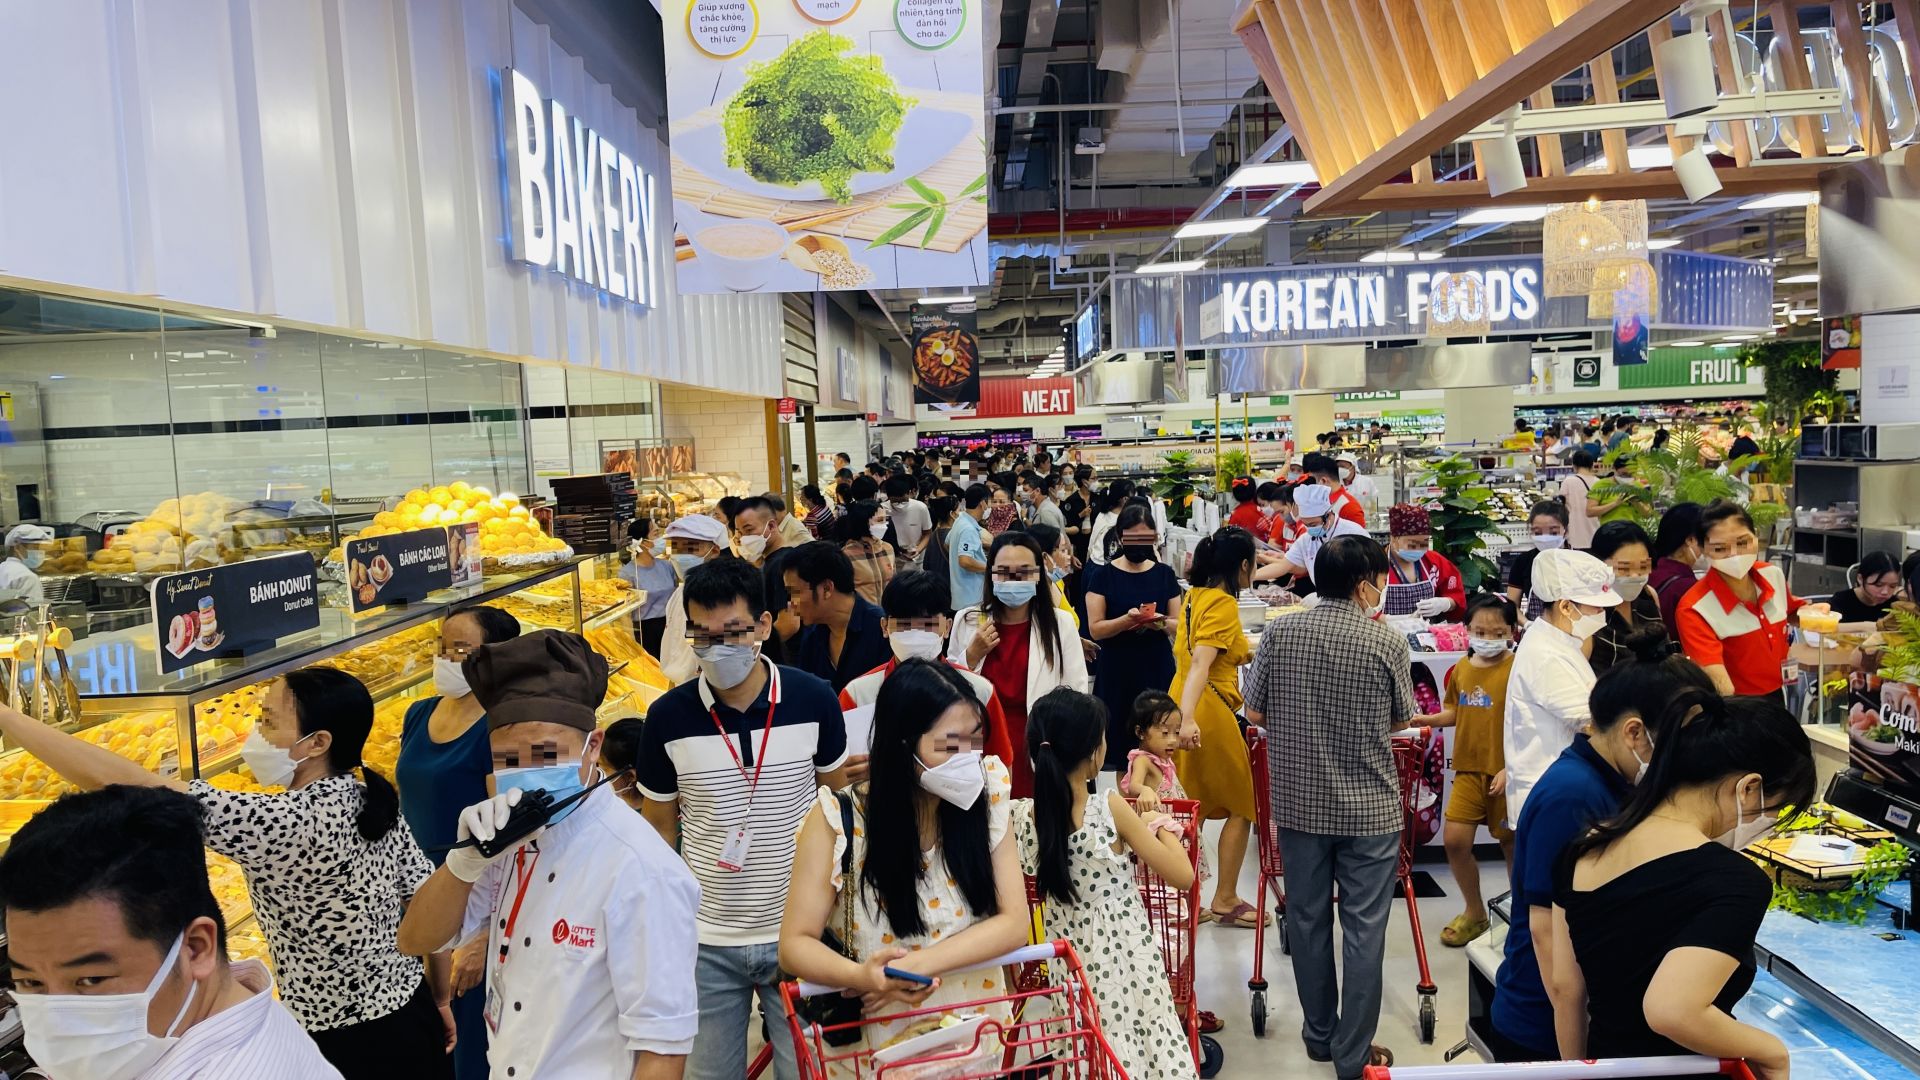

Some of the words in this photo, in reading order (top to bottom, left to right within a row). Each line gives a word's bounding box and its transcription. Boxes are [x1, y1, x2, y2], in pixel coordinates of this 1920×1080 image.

[698, 4, 717, 12] Giúp
[719, 3, 745, 11] xương
[817, 2, 840, 10] mạch
[945, 6, 963, 15] tính
[699, 25, 718, 33] tăng
[719, 24, 746, 32] cường
[916, 30, 932, 38] cho
[710, 35, 722, 44] thị
[723, 35, 737, 44] lực
[511, 68, 657, 309] BAKERY
[1222, 276, 1387, 334] KOREAN
[1406, 267, 1538, 325] FOODS
[1690, 359, 1742, 384] FRUIT
[1022, 389, 1071, 414] MEAT
[962, 543, 969, 551] 3
[399, 549, 419, 567] BÁNH
[418, 546, 432, 562] CÁC
[432, 545, 447, 561] LOẠI
[250, 581, 279, 604] BÁNH
[279, 575, 312, 597] DONUT
[284, 601, 300, 612] Donut
[300, 597, 314, 608] Cake
[1894, 735, 1920, 756] Maki
[571, 925, 596, 936] LOTTE
[568, 934, 595, 948] Mart
